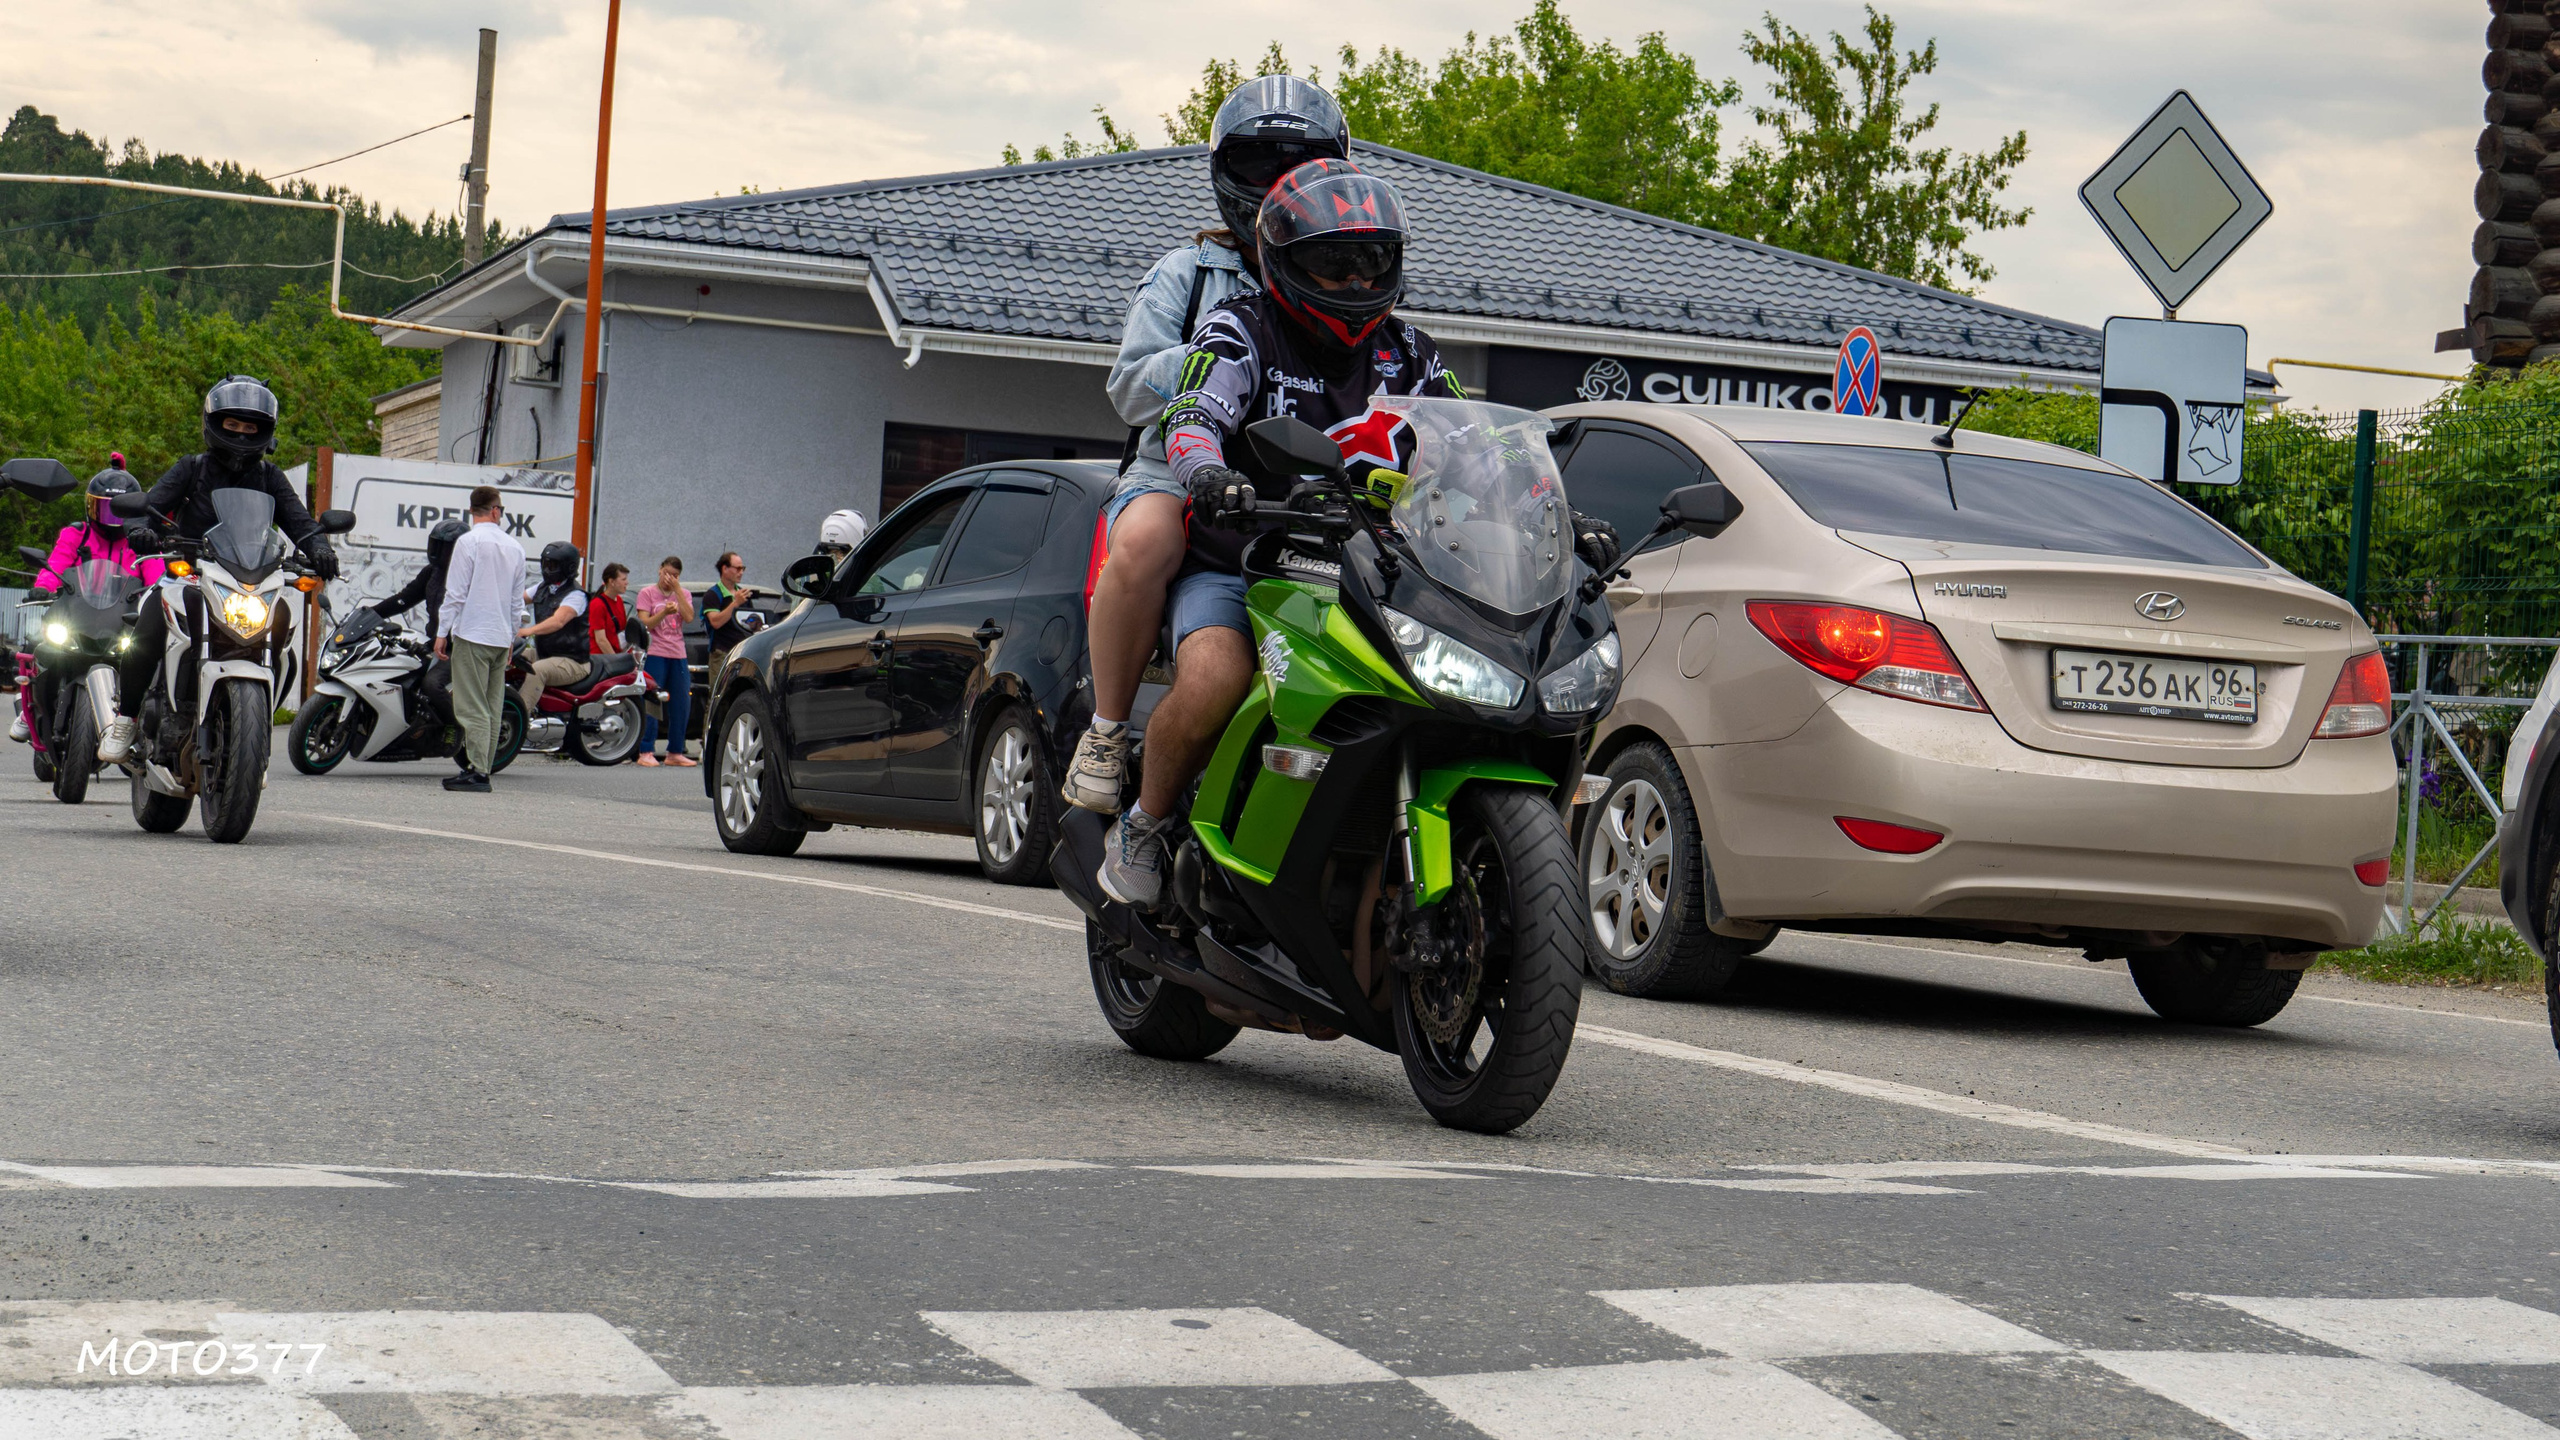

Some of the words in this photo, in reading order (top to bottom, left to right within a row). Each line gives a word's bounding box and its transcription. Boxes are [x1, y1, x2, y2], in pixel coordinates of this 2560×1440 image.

[1254, 120, 1309, 131] LS2
[396, 503, 537, 538] КРЕЖ
[1276, 548, 1341, 576] Kawasa
[1934, 582, 2008, 599] HYUNDAI
[2282, 615, 2343, 631] SOLARIS
[2212, 668, 2243, 696] 96
[2210, 695, 2234, 706] RUS
[2204, 712, 2253, 722] www.avtomir.ru
